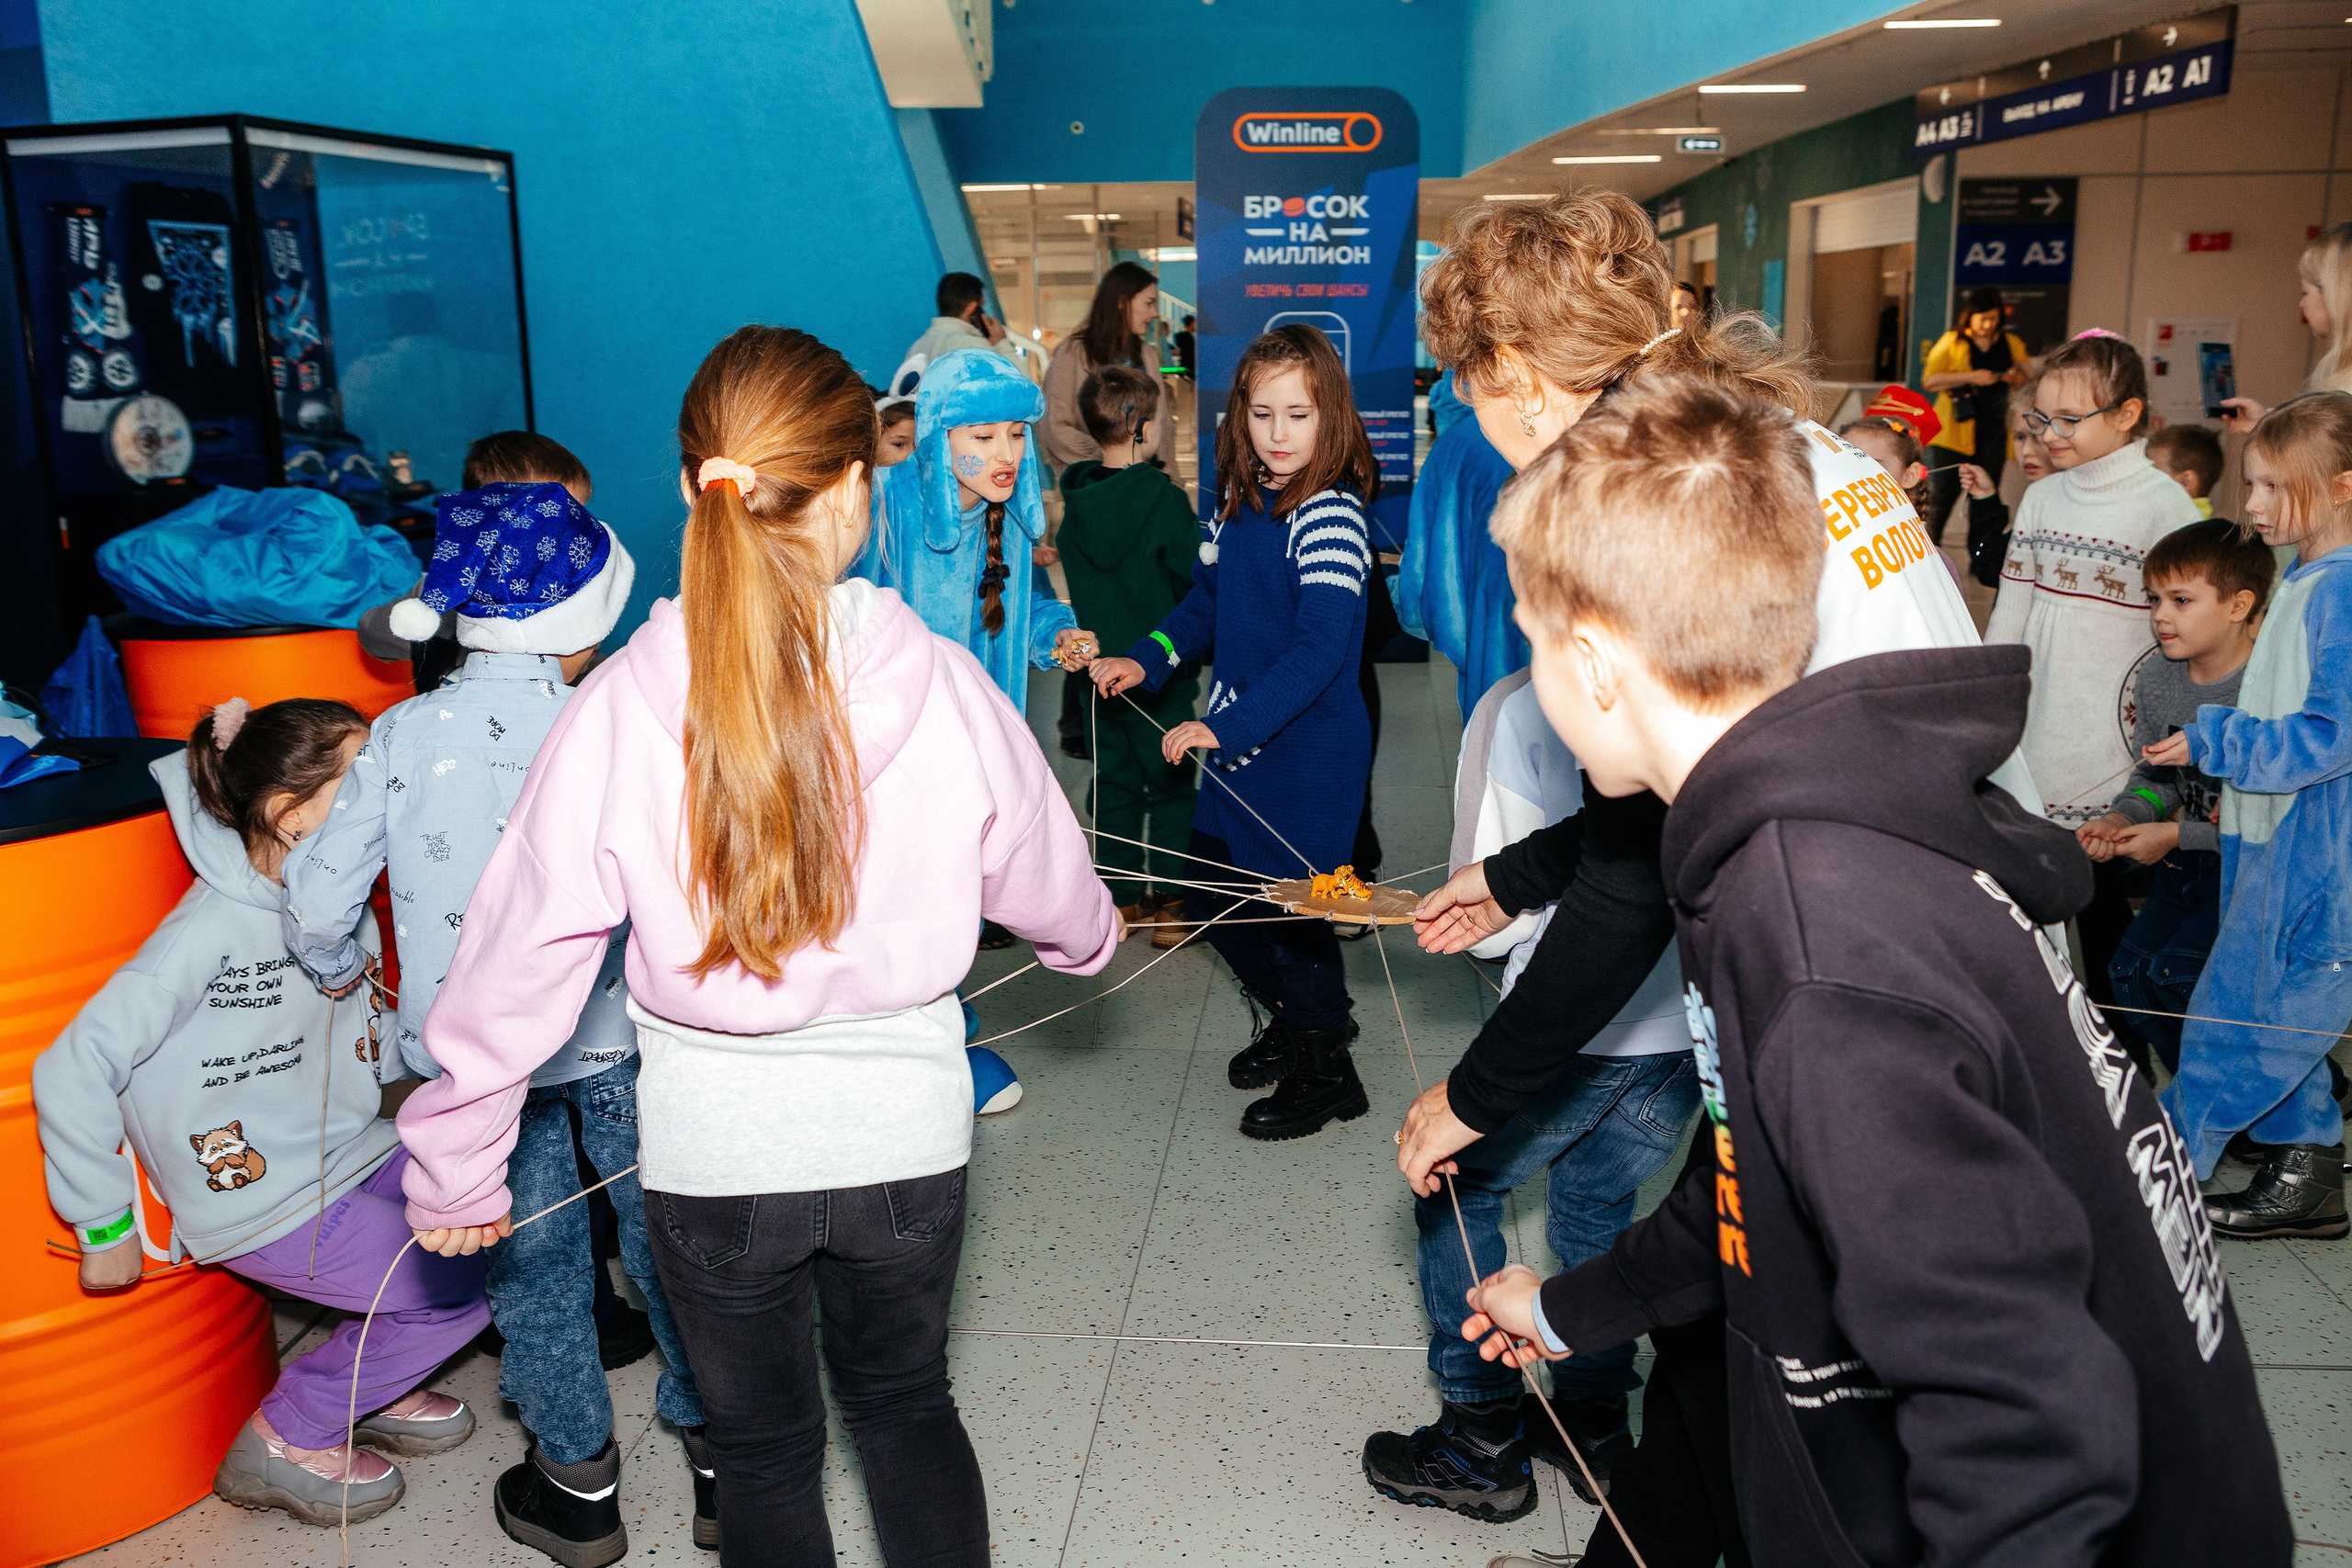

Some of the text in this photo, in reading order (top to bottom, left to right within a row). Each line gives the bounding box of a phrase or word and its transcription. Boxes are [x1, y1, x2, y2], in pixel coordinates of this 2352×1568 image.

[2143, 65, 2175, 97] A2
[1246, 122, 1341, 143] Winline
[1289, 221, 1329, 243] НА
[1244, 245, 1371, 265] МИЛЛИОН
[1963, 240, 2066, 266] A2 A3
[486, 716, 506, 735] MORE
[489, 729, 502, 742] DO
[420, 831, 448, 842] TRUST
[426, 840, 450, 850] YOUR
[424, 846, 451, 859] CRAZY
[432, 853, 450, 863] IDEA
[217, 956, 295, 979] AYS BRING
[207, 975, 283, 994] YOUR OWN
[209, 994, 282, 1009] SUNSHINE
[201, 1057, 235, 1067] WAKE
[578, 1049, 627, 1066] RESPECT
[201, 1077, 229, 1089] AND
[233, 1070, 250, 1082] BE
